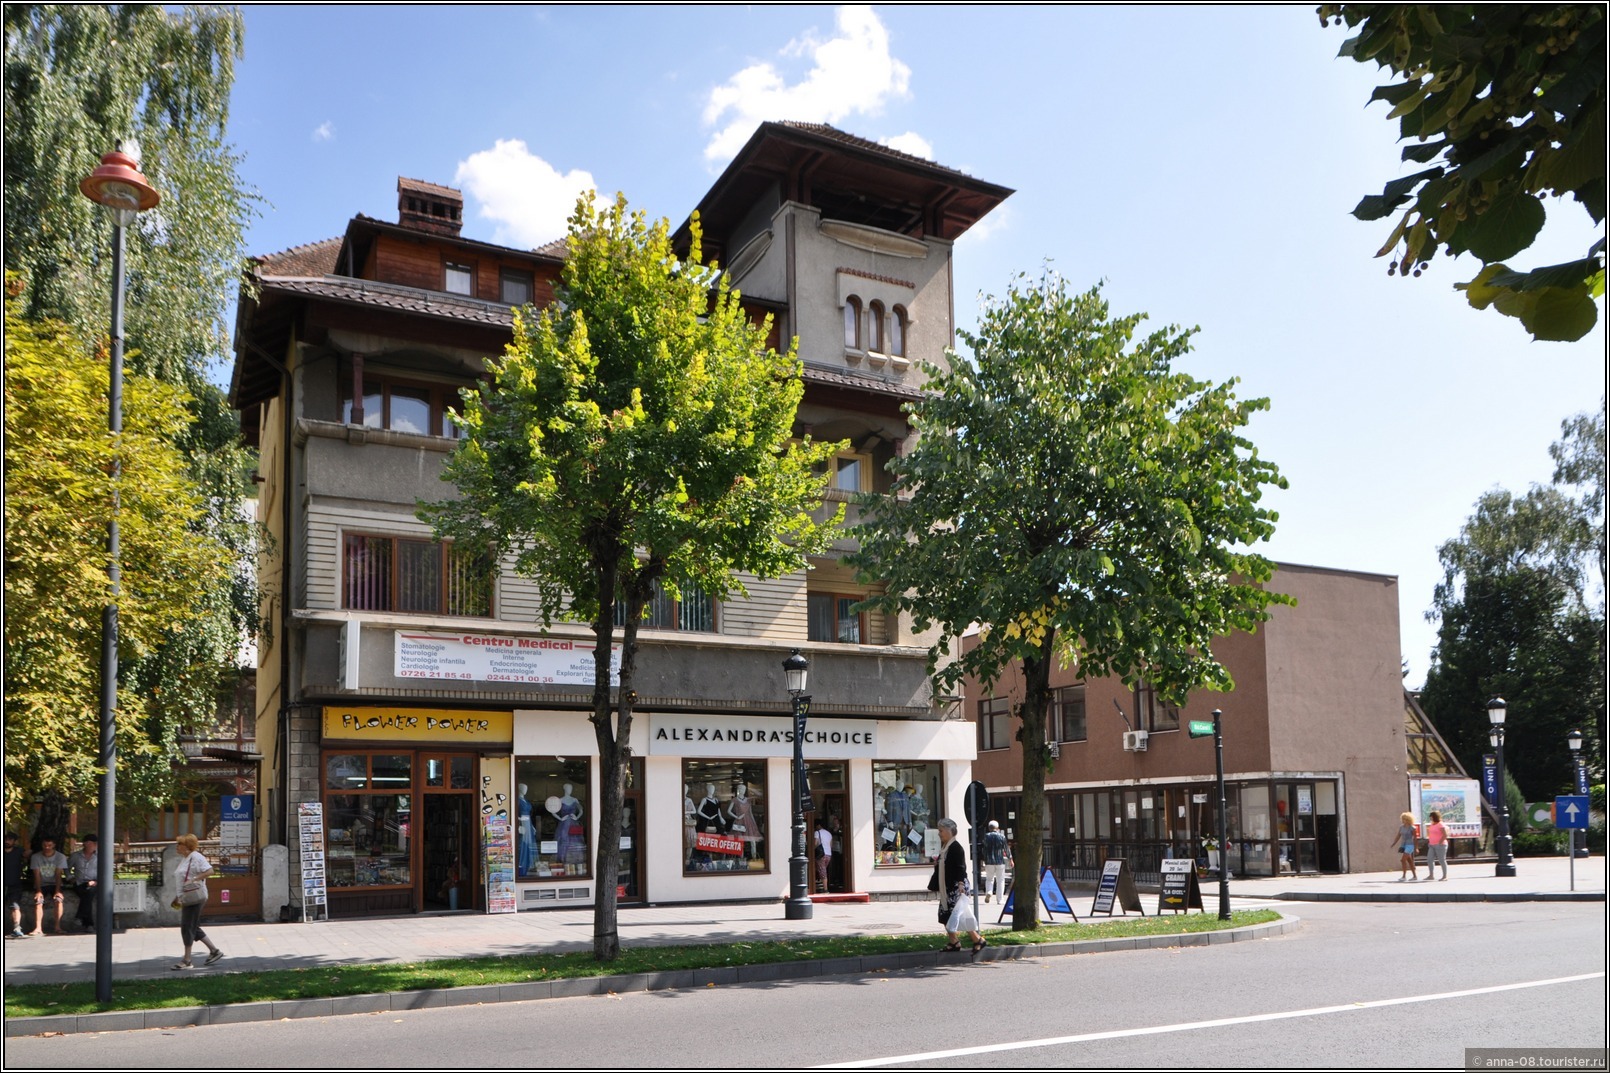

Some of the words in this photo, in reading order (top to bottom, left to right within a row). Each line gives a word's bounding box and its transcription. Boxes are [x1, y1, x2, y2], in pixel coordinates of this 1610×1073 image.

[401, 643, 446, 651] Stomatologie
[463, 636, 514, 647] Centru
[518, 639, 573, 651] Medical
[401, 650, 438, 658] Neurologie
[485, 647, 514, 655] Medicina
[401, 656, 438, 665] Neurologie
[490, 660, 538, 669] Endocrinologie
[401, 663, 440, 671] Cardiologie
[492, 667, 535, 675] Dermatologie
[342, 714, 419, 731] FLOWER
[426, 716, 489, 734] POWER
[656, 728, 794, 743] ALEXANDRA'S
[804, 731, 873, 744] CHOICE
[698, 836, 719, 849] SUPER
[719, 839, 742, 851] OFERTA
